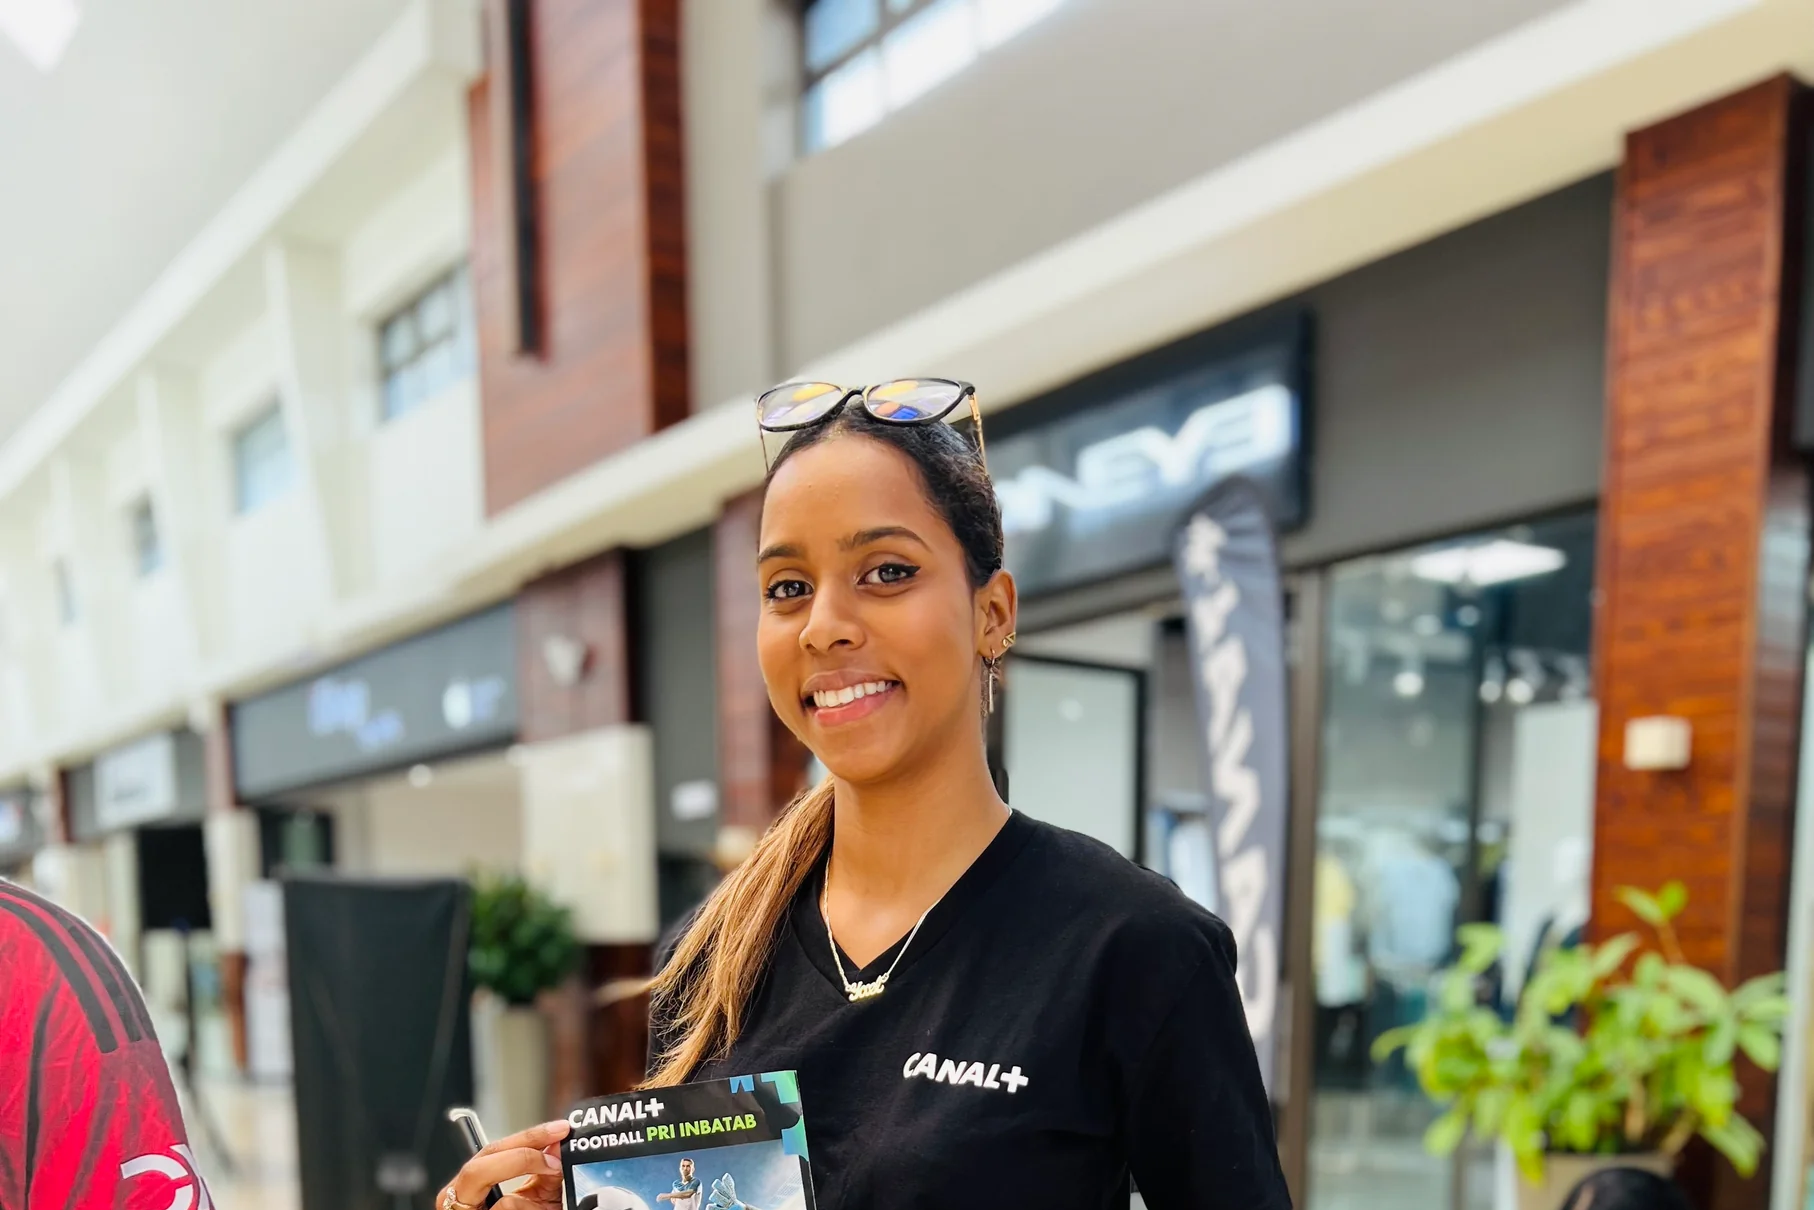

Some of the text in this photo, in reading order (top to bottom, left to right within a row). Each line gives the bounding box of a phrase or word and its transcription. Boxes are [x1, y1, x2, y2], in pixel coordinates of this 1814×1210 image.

[903, 1052, 1029, 1093] CANAL+
[568, 1098, 664, 1128] CANAL+
[570, 1114, 757, 1151] FOOTBALL PRI INBATAB
